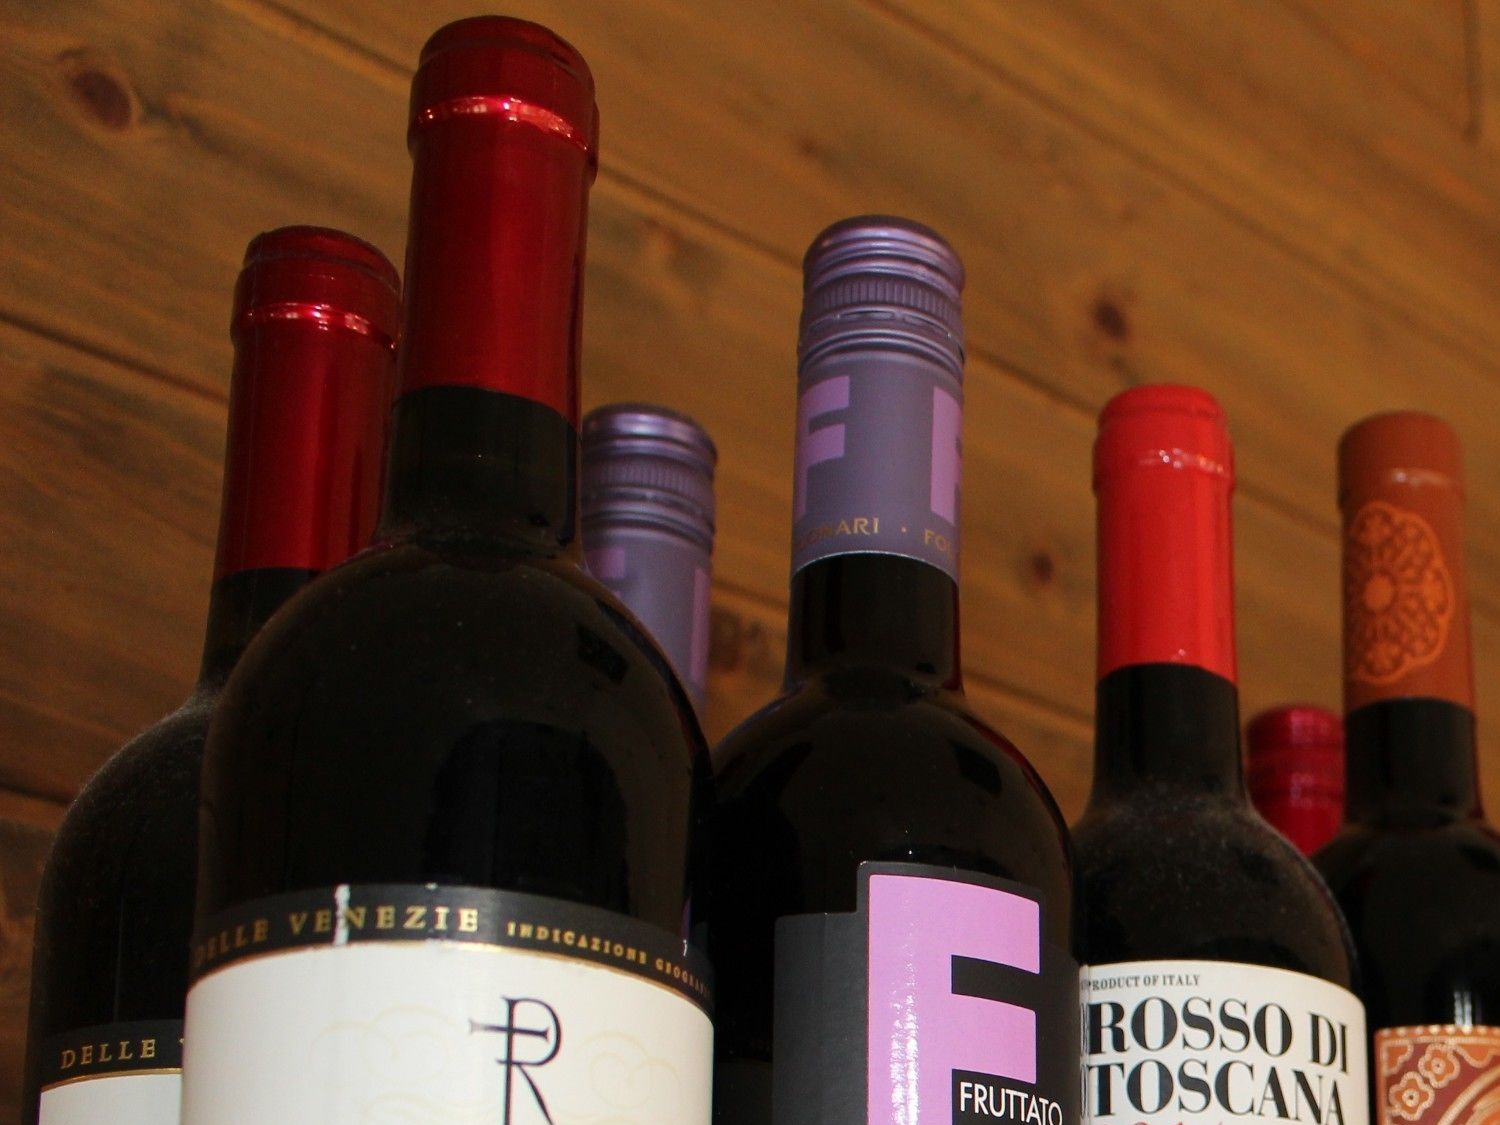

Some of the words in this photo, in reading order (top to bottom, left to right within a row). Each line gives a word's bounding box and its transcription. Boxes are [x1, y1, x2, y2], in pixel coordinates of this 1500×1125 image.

[288, 904, 479, 937] VENEZIE
[506, 919, 648, 964] INDICAZIONE
[1143, 974, 1159, 987] OF
[1162, 973, 1201, 986] ITALY
[60, 1038, 156, 1069] DELLE
[1086, 995, 1294, 1058] ROSSO
[1308, 1011, 1349, 1075] DI
